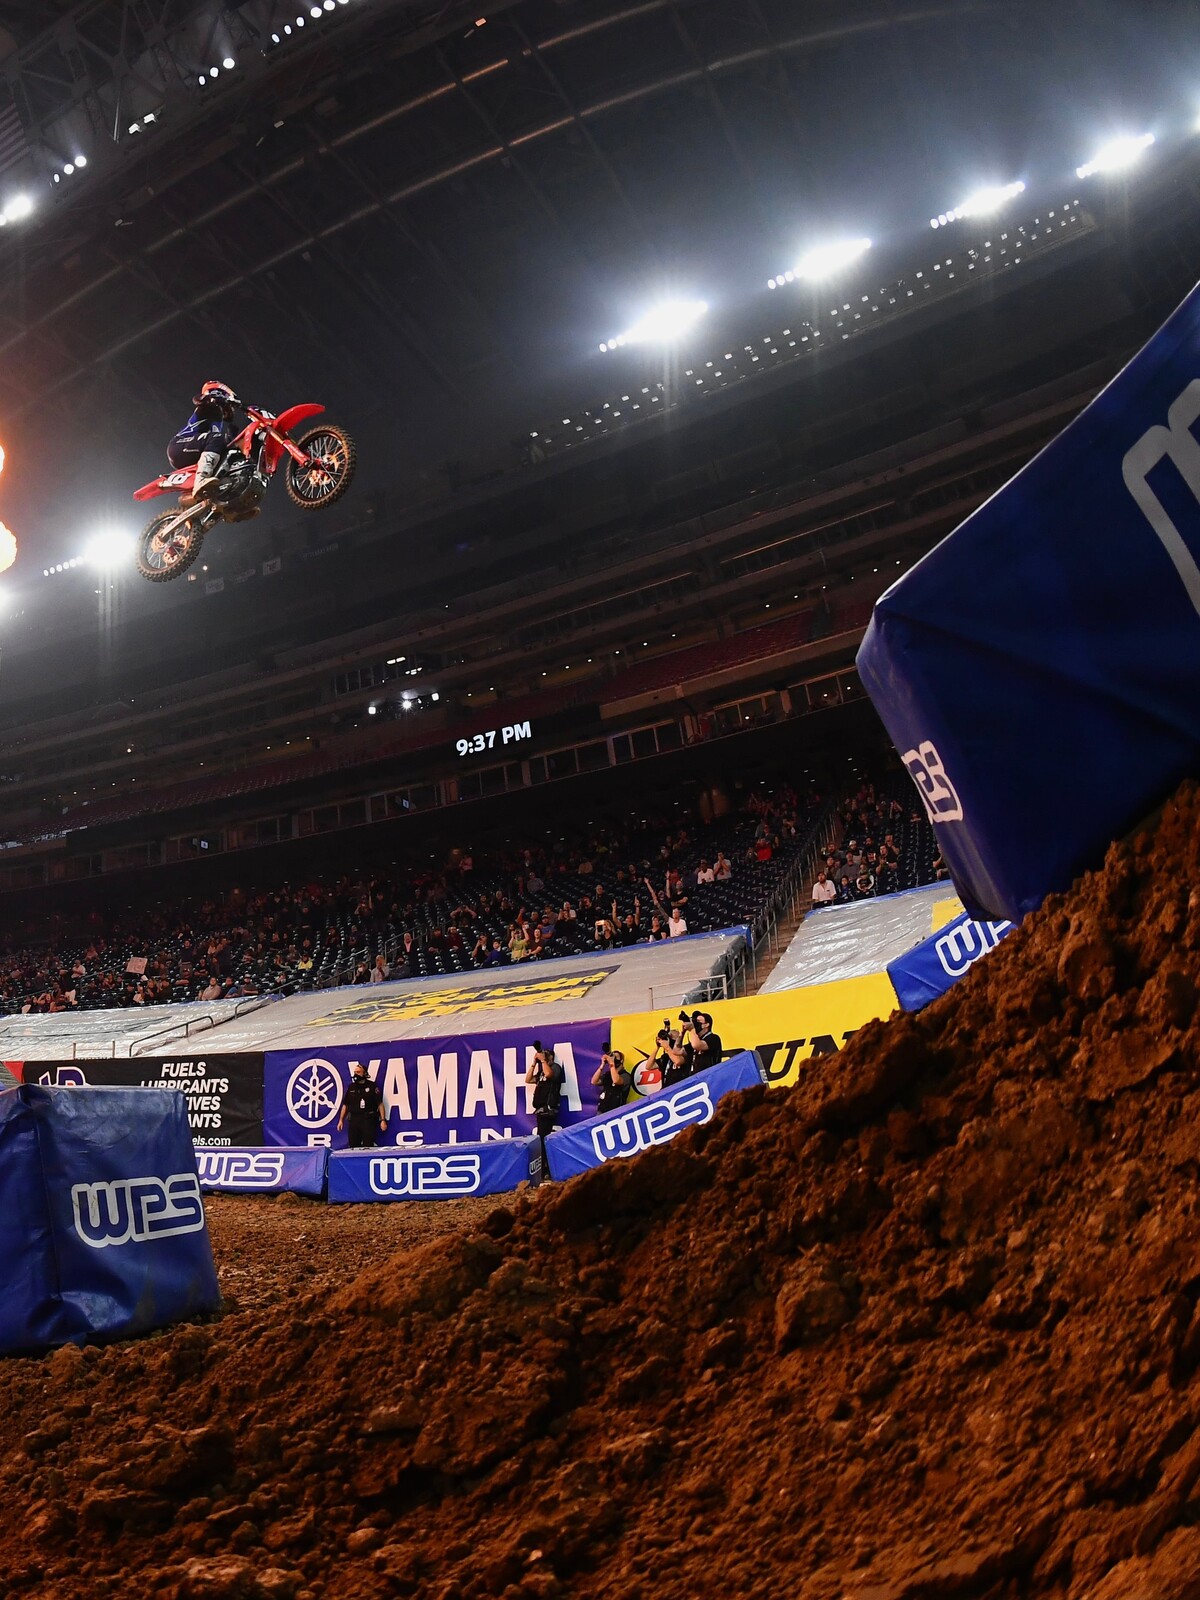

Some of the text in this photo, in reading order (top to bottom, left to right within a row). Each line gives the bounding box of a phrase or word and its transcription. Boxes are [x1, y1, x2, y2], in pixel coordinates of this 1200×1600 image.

[456, 721, 532, 756] 9:37 PM
[161, 1061, 206, 1077] FUELS
[590, 1081, 714, 1163] WPS
[193, 1152, 285, 1187] WPS
[369, 1154, 481, 1195] WPS
[71, 1172, 203, 1248] WPS
